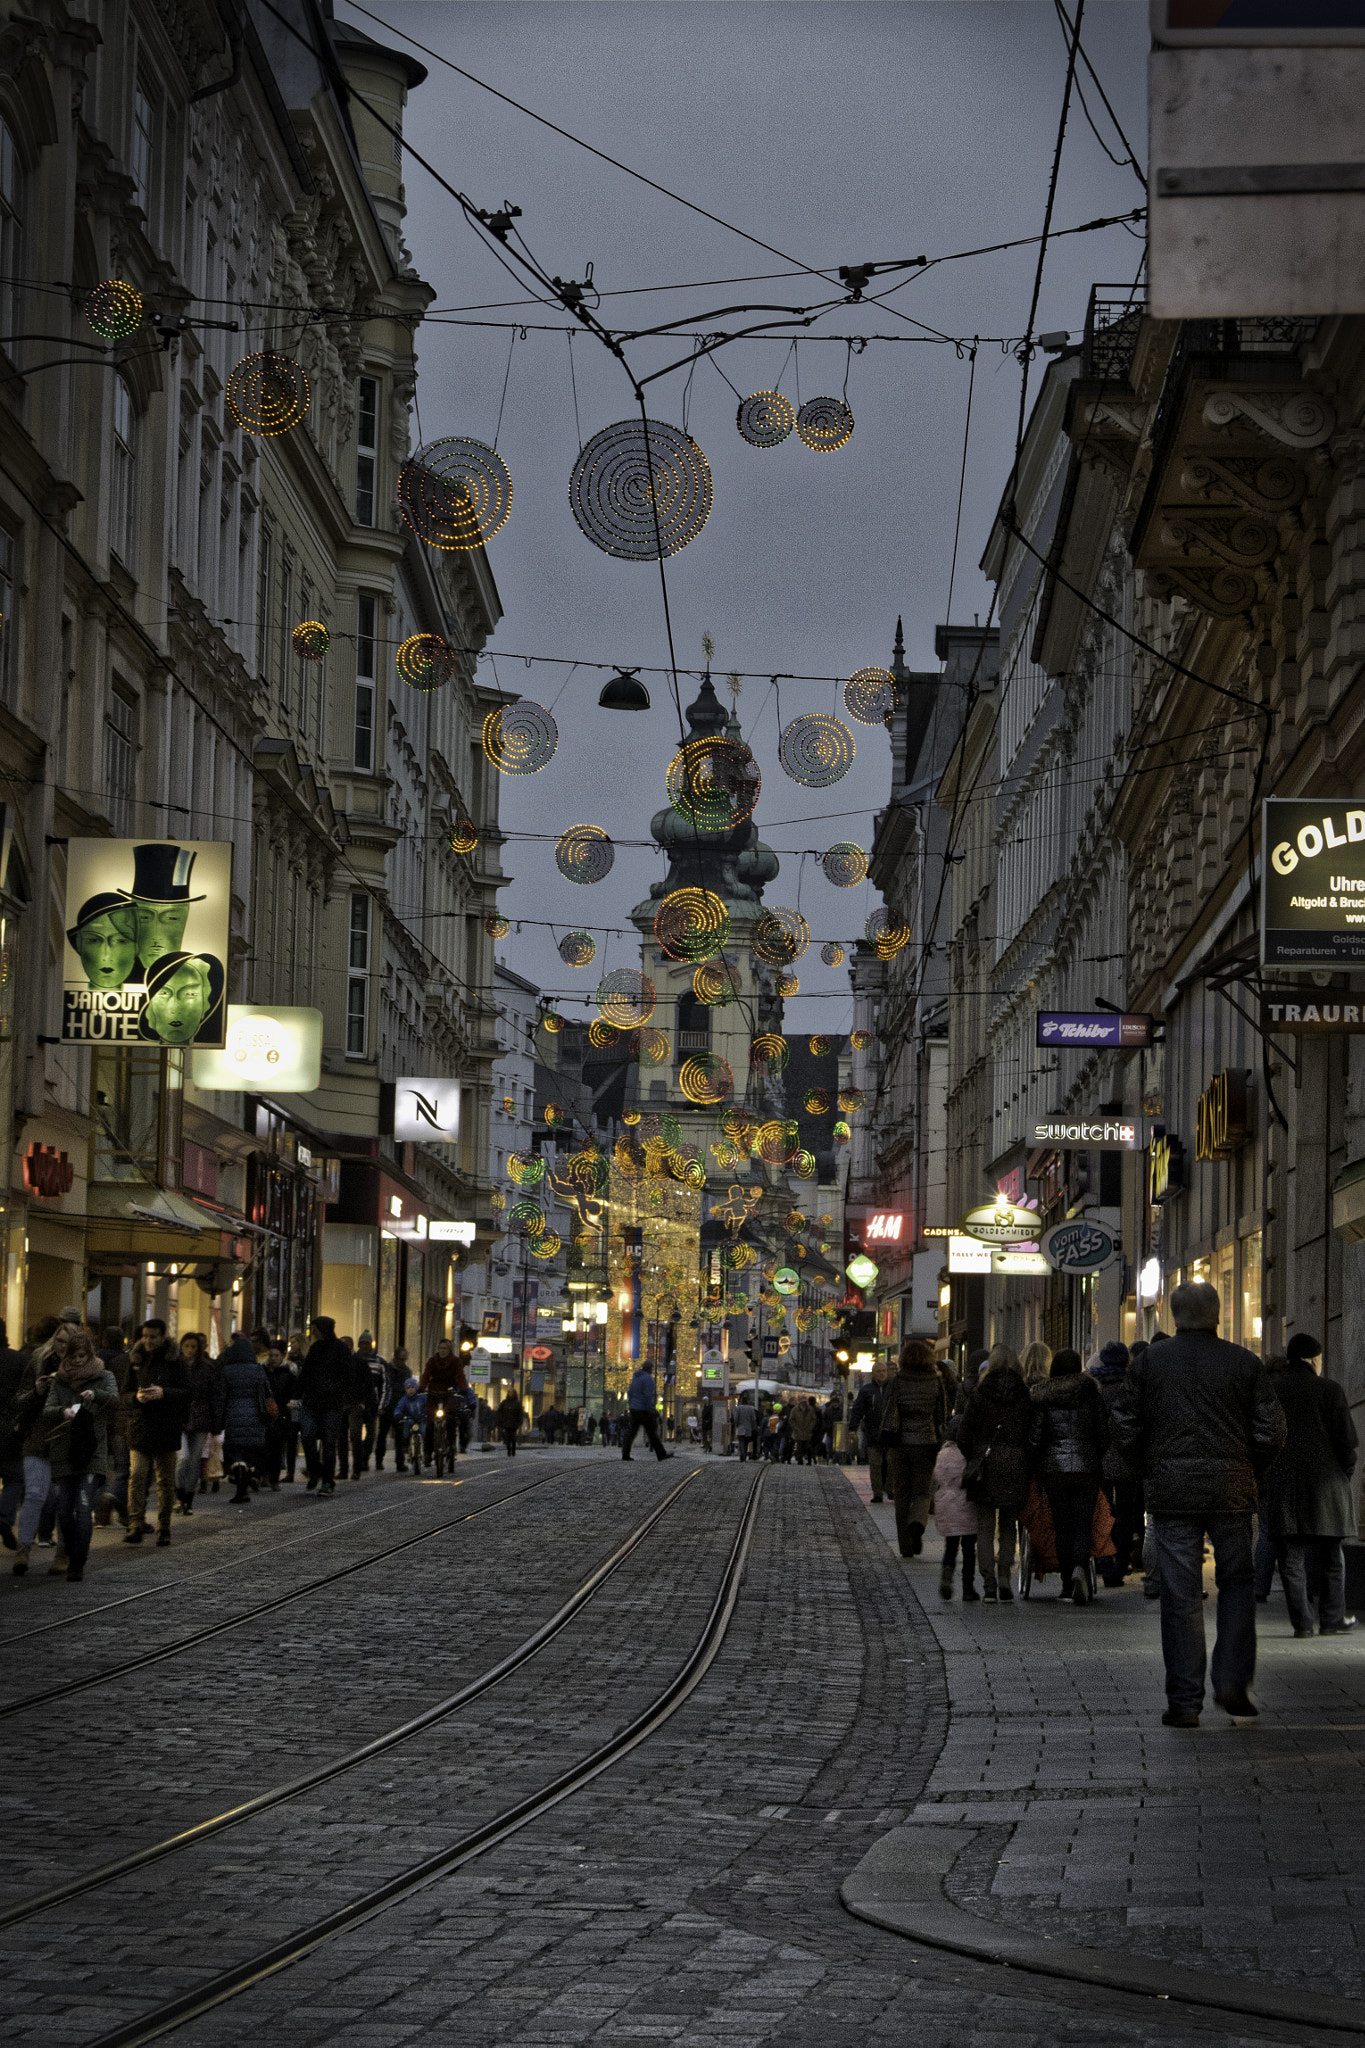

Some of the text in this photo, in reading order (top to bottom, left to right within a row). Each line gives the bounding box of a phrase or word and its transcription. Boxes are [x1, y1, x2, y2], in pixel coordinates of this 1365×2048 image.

[1271, 810, 1365, 875] GOLD
[1290, 896, 1365, 910] Altgold & Bruc
[1277, 946, 1337, 956] Reparaturen
[67, 991, 142, 1011] JANOUT
[1268, 1004, 1365, 1022] TRAUR
[67, 1009, 138, 1039] HÜTE
[1059, 1023, 1115, 1038] Tchibo
[1034, 1122, 1119, 1140] swatch
[866, 1214, 903, 1240] H&M
[1055, 1230, 1079, 1248] vom
[1056, 1232, 1102, 1268] FASS
